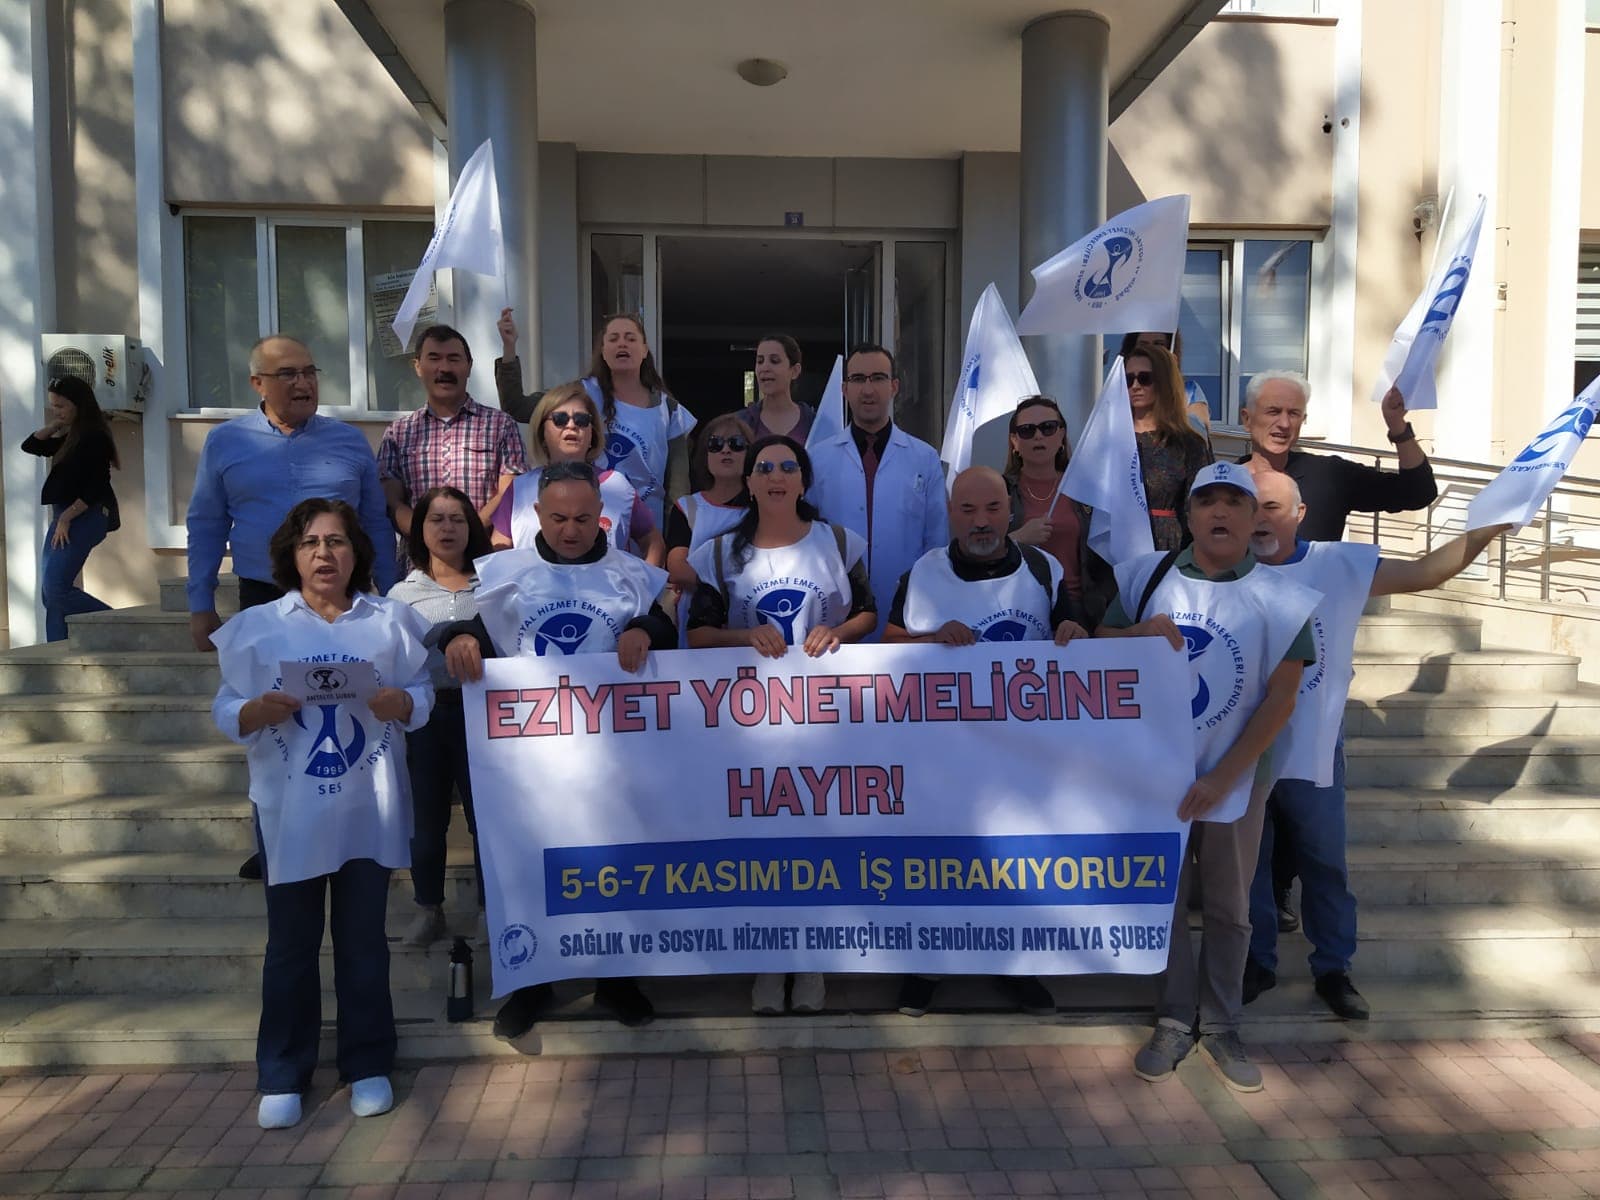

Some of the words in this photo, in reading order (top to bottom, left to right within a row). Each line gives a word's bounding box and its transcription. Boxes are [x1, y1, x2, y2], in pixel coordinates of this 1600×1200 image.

[537, 600, 578, 617] HİZMET
[581, 601, 622, 642] EMEKÇİLE
[1206, 618, 1246, 674] EMEKÇİLERİ
[485, 675, 681, 740] EZİYET
[690, 658, 1141, 728] YÖNETMELİĞİNE
[1206, 678, 1244, 729] SENDİKASI
[366, 722, 393, 765] NDİKASI
[318, 782, 342, 795] SES
[727, 765, 905, 818] HAYIR!
[561, 865, 655, 900] 5-6-7
[859, 851, 893, 900] İŞ
[904, 855, 1167, 890] BIRAKIYORUZ!
[560, 928, 625, 957] SAĞLIK
[630, 935, 653, 954] ve
[659, 928, 727, 953] SOSYAL
[733, 922, 799, 951] HİZMET
[806, 921, 912, 957] EMEKÇİLERİ
[918, 922, 1015, 951] SENDİKASI
[1022, 926, 1103, 951] ANTALYA
